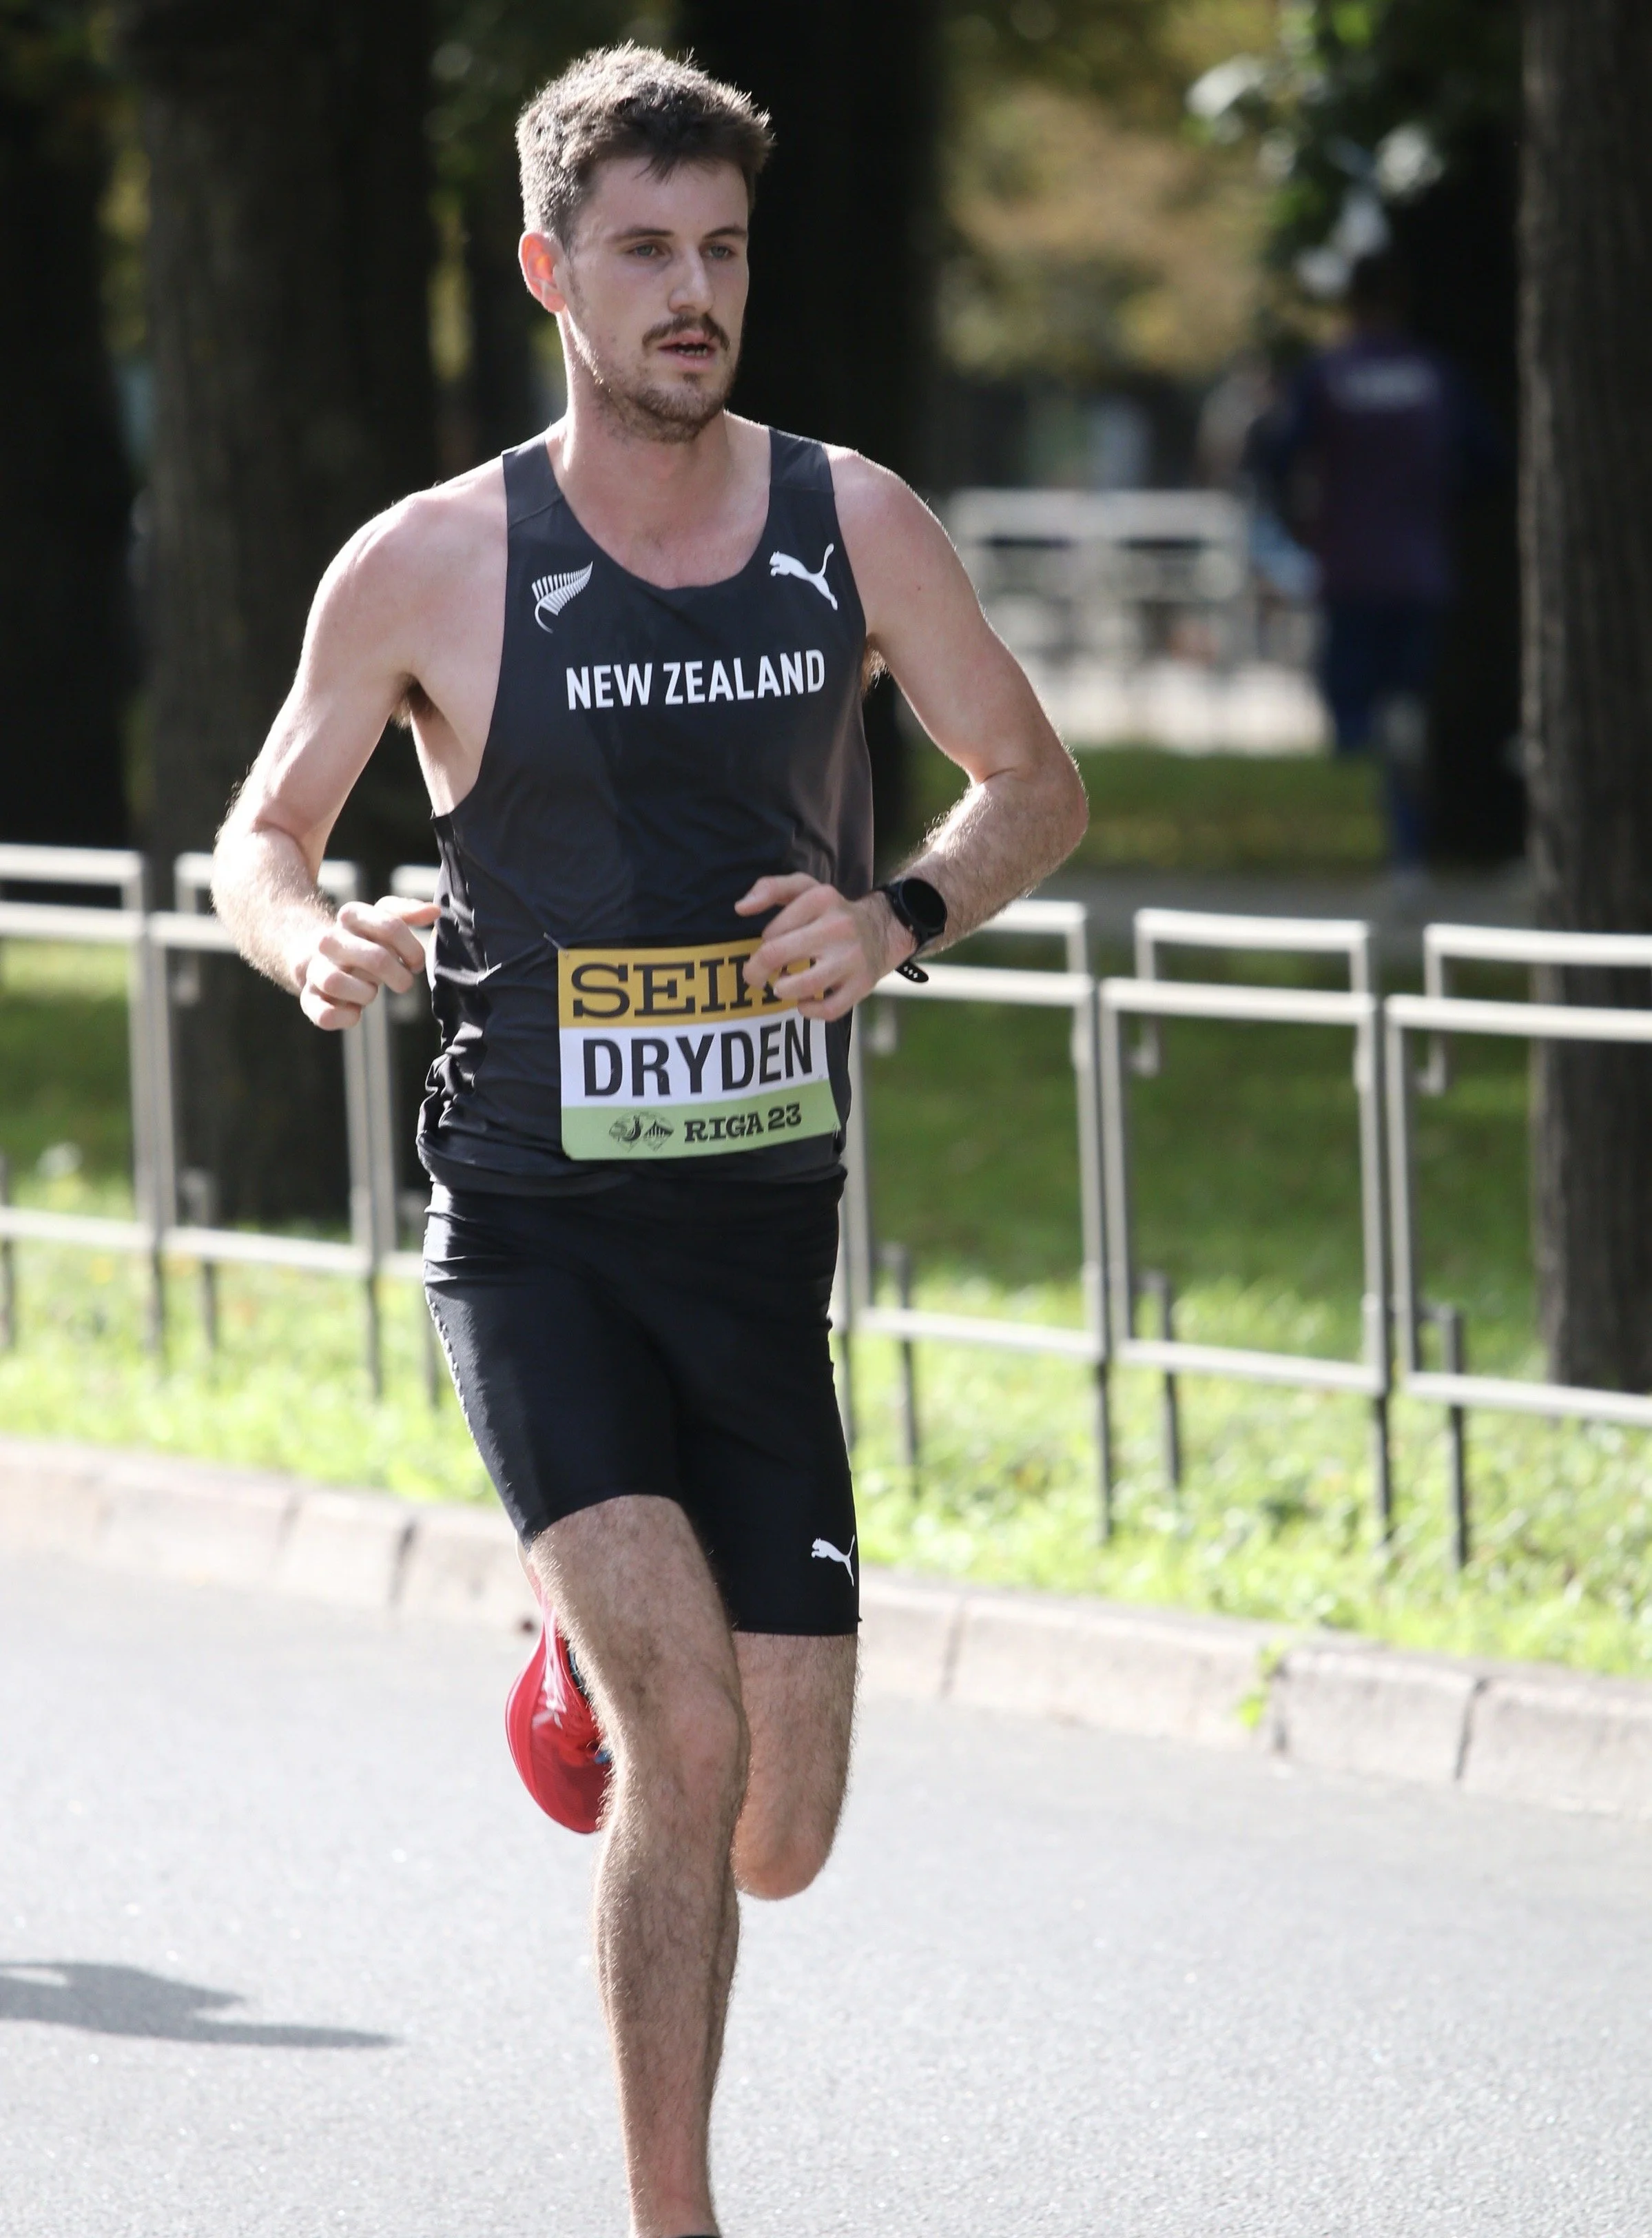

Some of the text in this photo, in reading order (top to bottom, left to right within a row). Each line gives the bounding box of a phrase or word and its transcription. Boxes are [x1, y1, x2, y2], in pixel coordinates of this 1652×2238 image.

[566, 649, 825, 710] NEW ZEALAND
[571, 953, 834, 1018] SEIK
[582, 1018, 813, 1098] DRYDEN
[684, 1102, 802, 1144] RIGA 23
